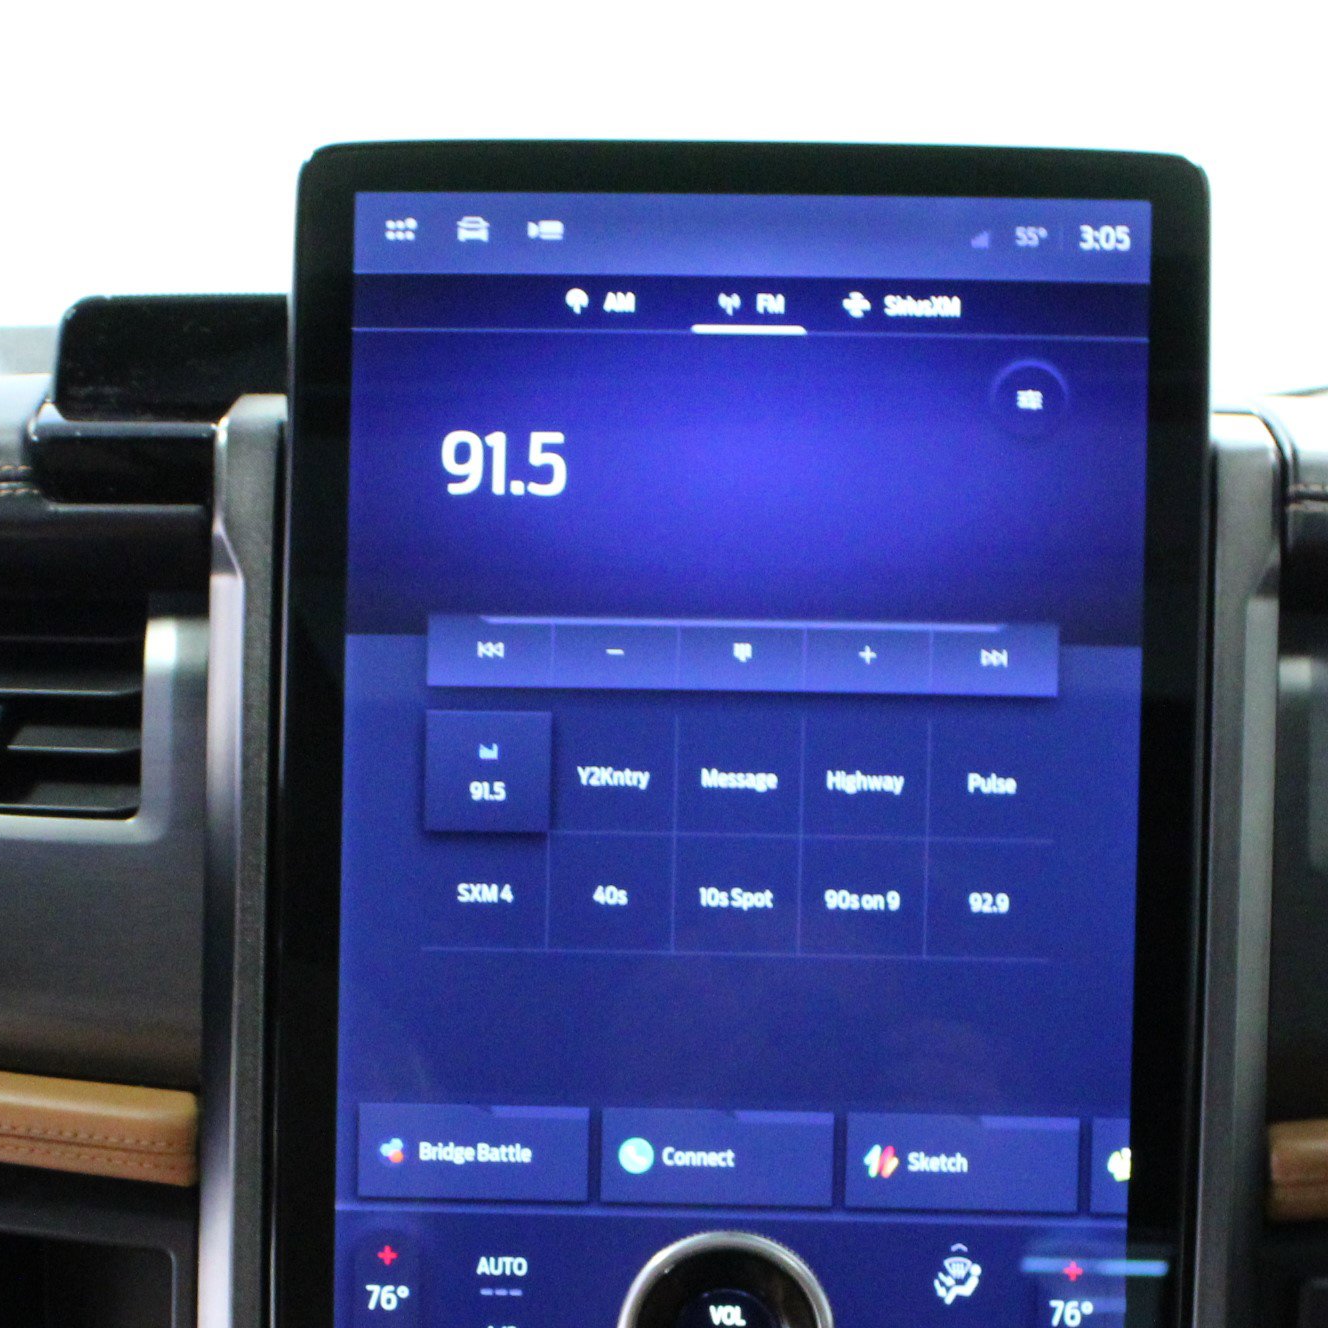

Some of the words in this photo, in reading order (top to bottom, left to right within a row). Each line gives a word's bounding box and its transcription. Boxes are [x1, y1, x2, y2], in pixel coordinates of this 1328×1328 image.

[1079, 224, 1131, 251] 3:05
[603, 291, 636, 313] AM
[756, 293, 785, 314] FM
[884, 295, 961, 318] SiriusXM
[441, 430, 568, 497] 91.5
[576, 766, 650, 790] Y2Kntry
[700, 767, 778, 793] Message
[825, 770, 904, 796] Highway
[967, 773, 1017, 795] Pulse
[469, 781, 507, 801] 91.5
[456, 883, 499, 904] SXM
[500, 883, 514, 904] 4
[592, 885, 628, 906] 40s
[699, 886, 729, 908] 10s
[730, 887, 773, 911] Spot
[824, 889, 860, 911] 90s
[860, 893, 885, 911] on
[885, 890, 901, 912] 9
[968, 892, 1010, 914] 92.9
[418, 1141, 475, 1165] Bridge
[476, 1143, 532, 1164] Battle
[661, 1147, 736, 1167] Connect
[907, 1152, 969, 1174] Sketch
[476, 1256, 528, 1277] AUTO
[365, 1284, 410, 1312] 76°
[709, 1304, 747, 1327] VOL
[1049, 1299, 1094, 1328] 76°
